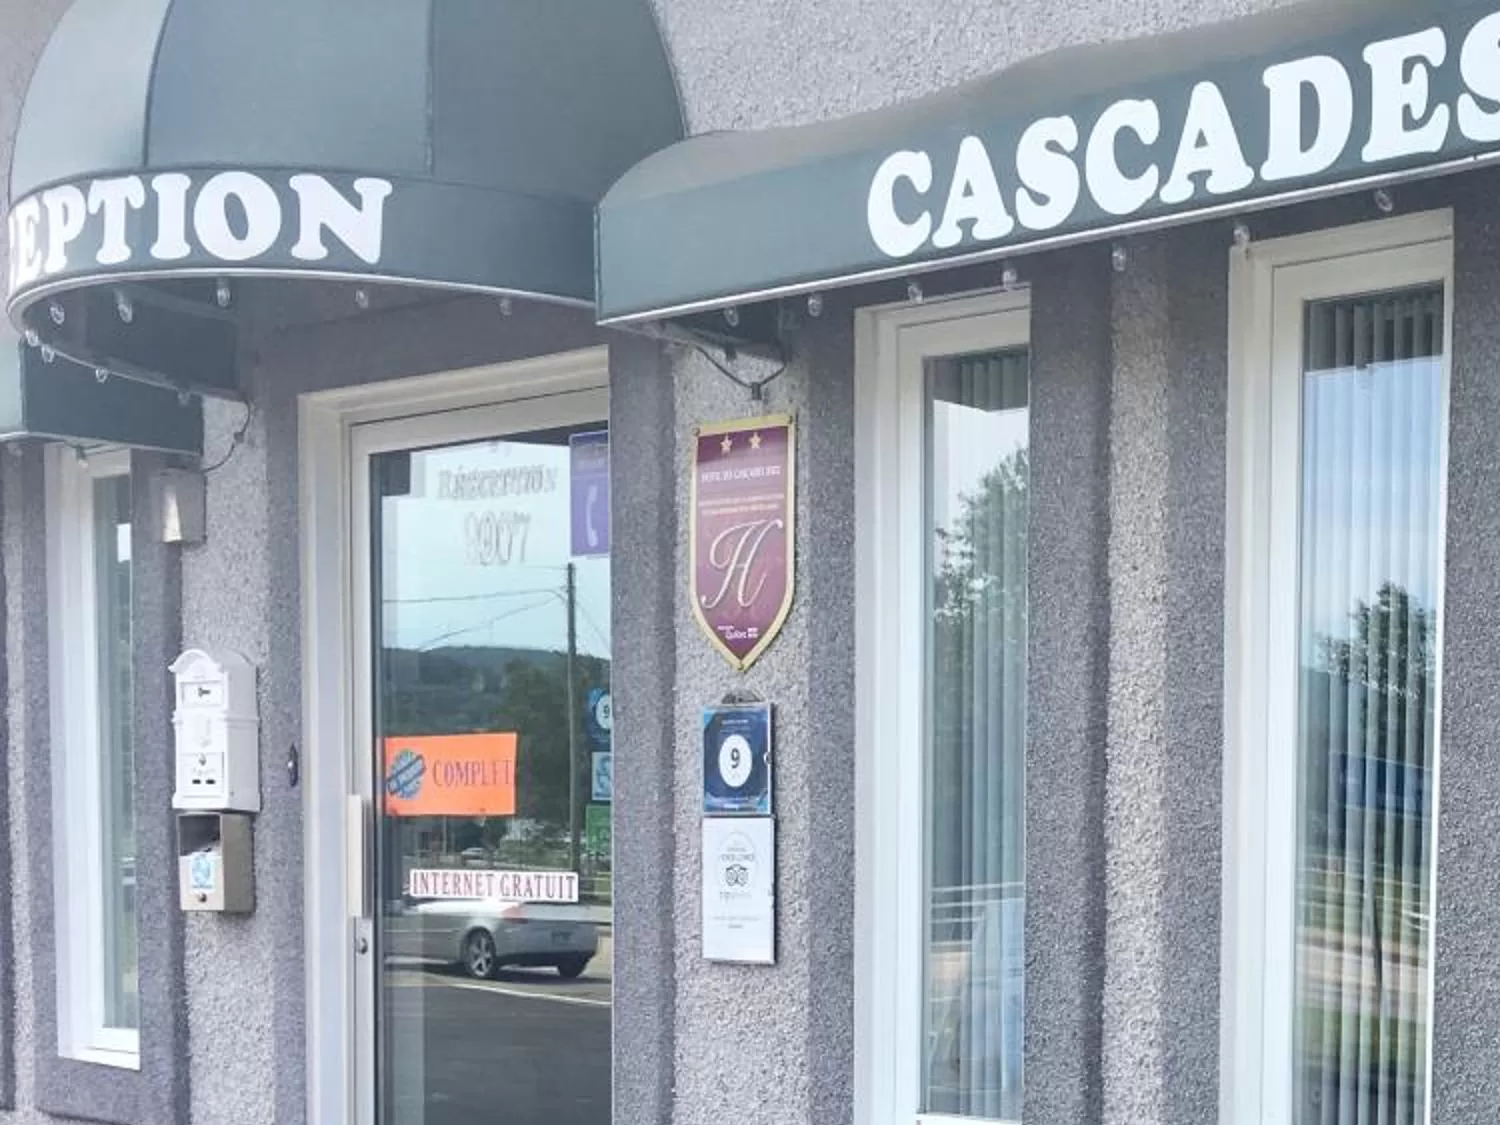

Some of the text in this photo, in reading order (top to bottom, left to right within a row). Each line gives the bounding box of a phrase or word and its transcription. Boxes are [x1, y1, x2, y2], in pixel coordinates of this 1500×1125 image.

[8, 171, 393, 300] EPTION
[701, 519, 783, 608] H
[730, 748, 741, 768] 9
[413, 872, 576, 899] INTERNET GRATUIT
